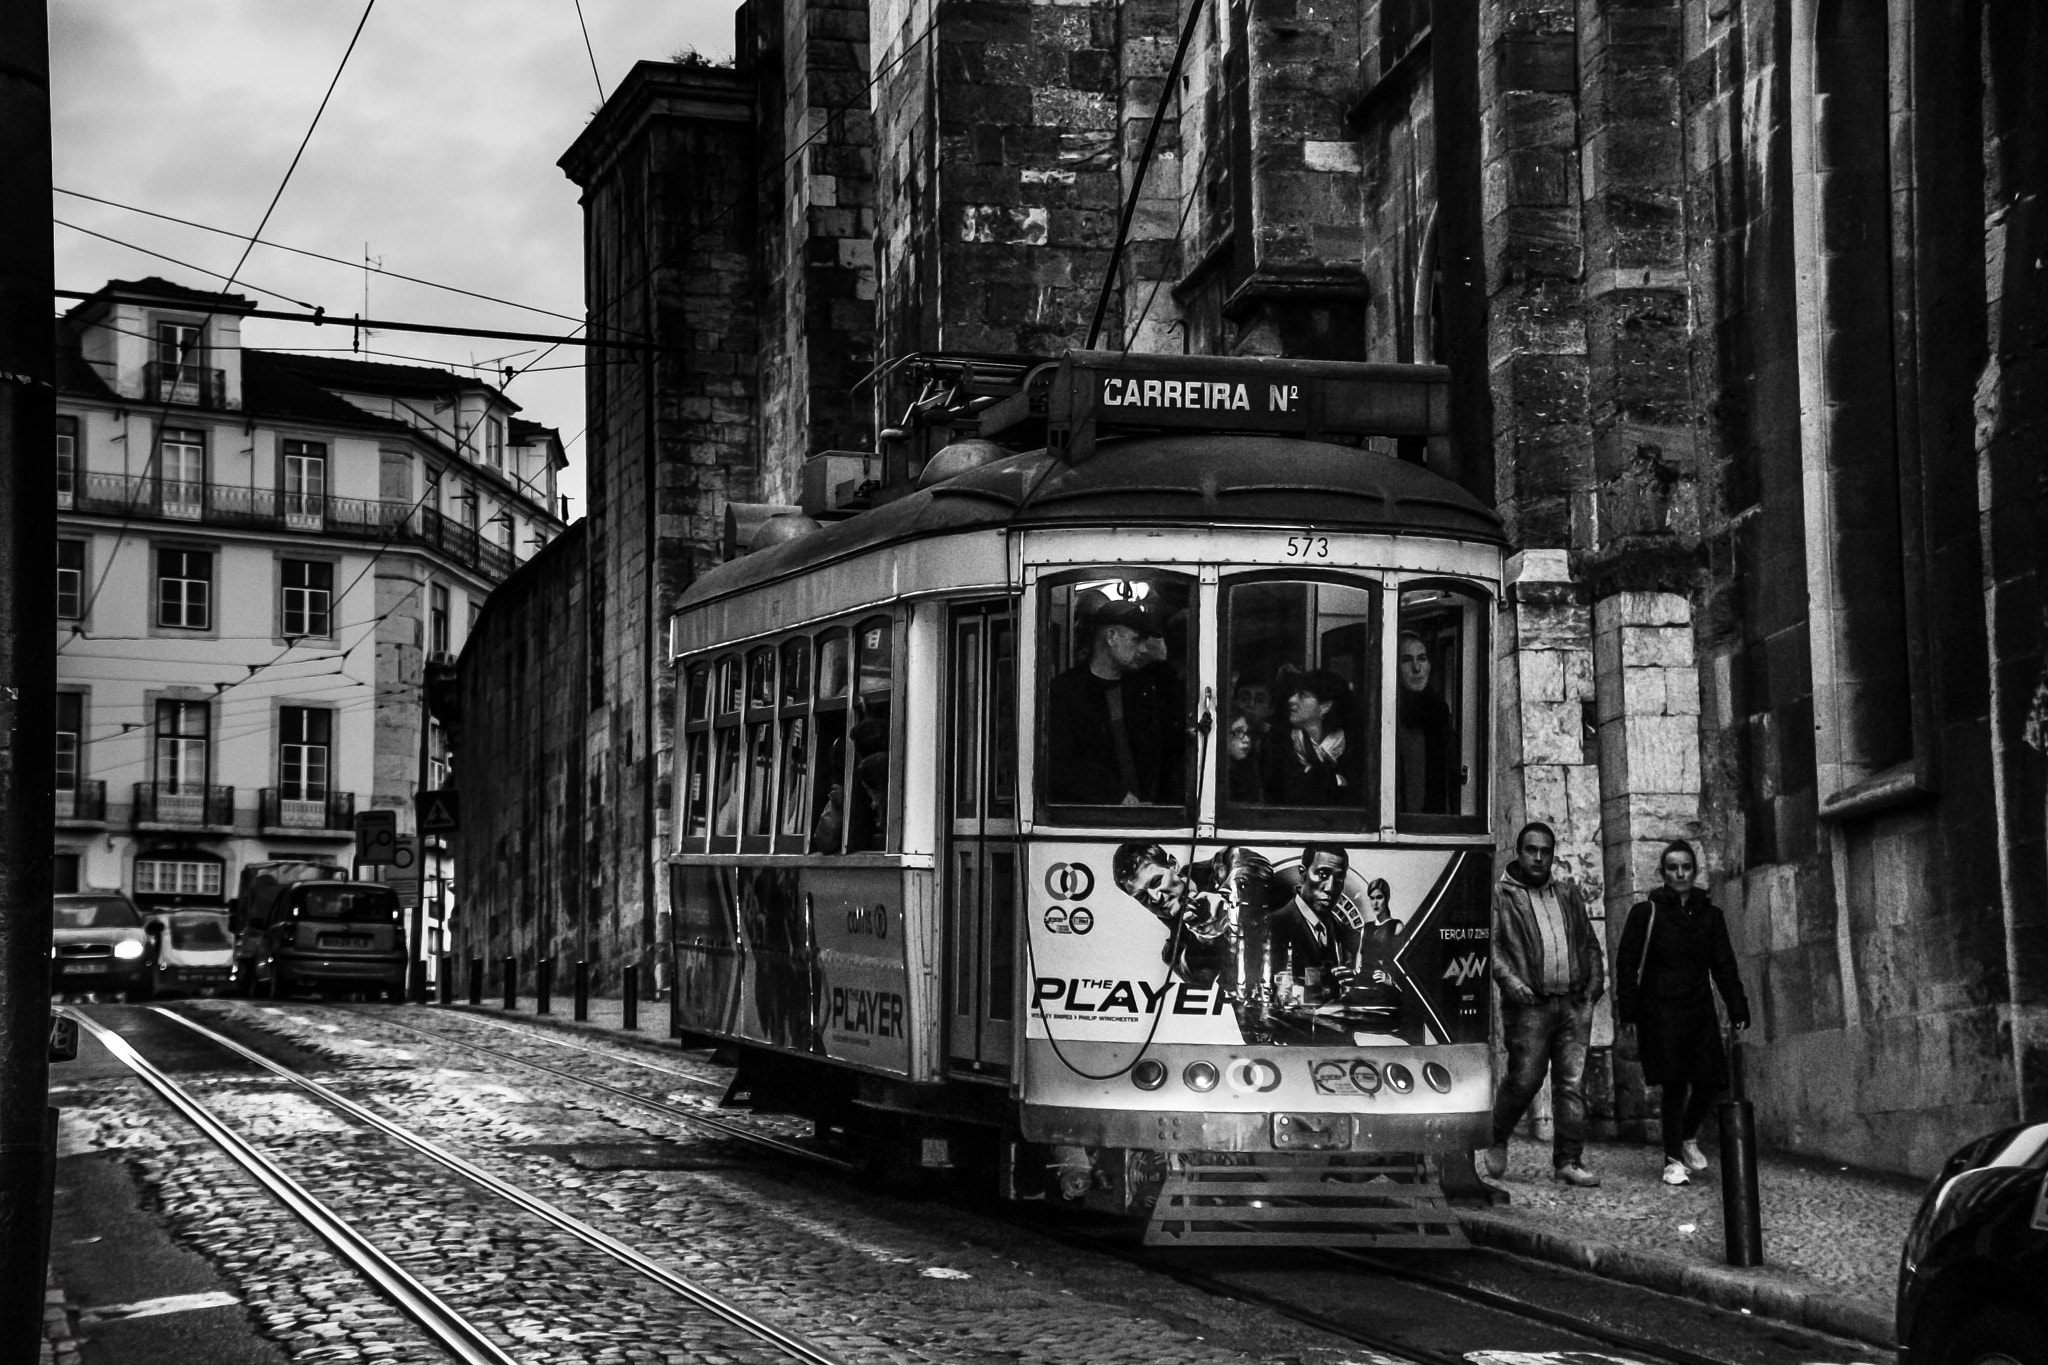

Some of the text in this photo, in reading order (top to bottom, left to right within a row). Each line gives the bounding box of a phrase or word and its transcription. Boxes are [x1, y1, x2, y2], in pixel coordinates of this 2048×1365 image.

[1104, 378, 1250, 411] CARREIRA
[1286, 537, 1328, 558] 573
[1082, 979, 1113, 989] THE
[1442, 952, 1487, 986] AXN
[832, 987, 903, 1039] PLAYER
